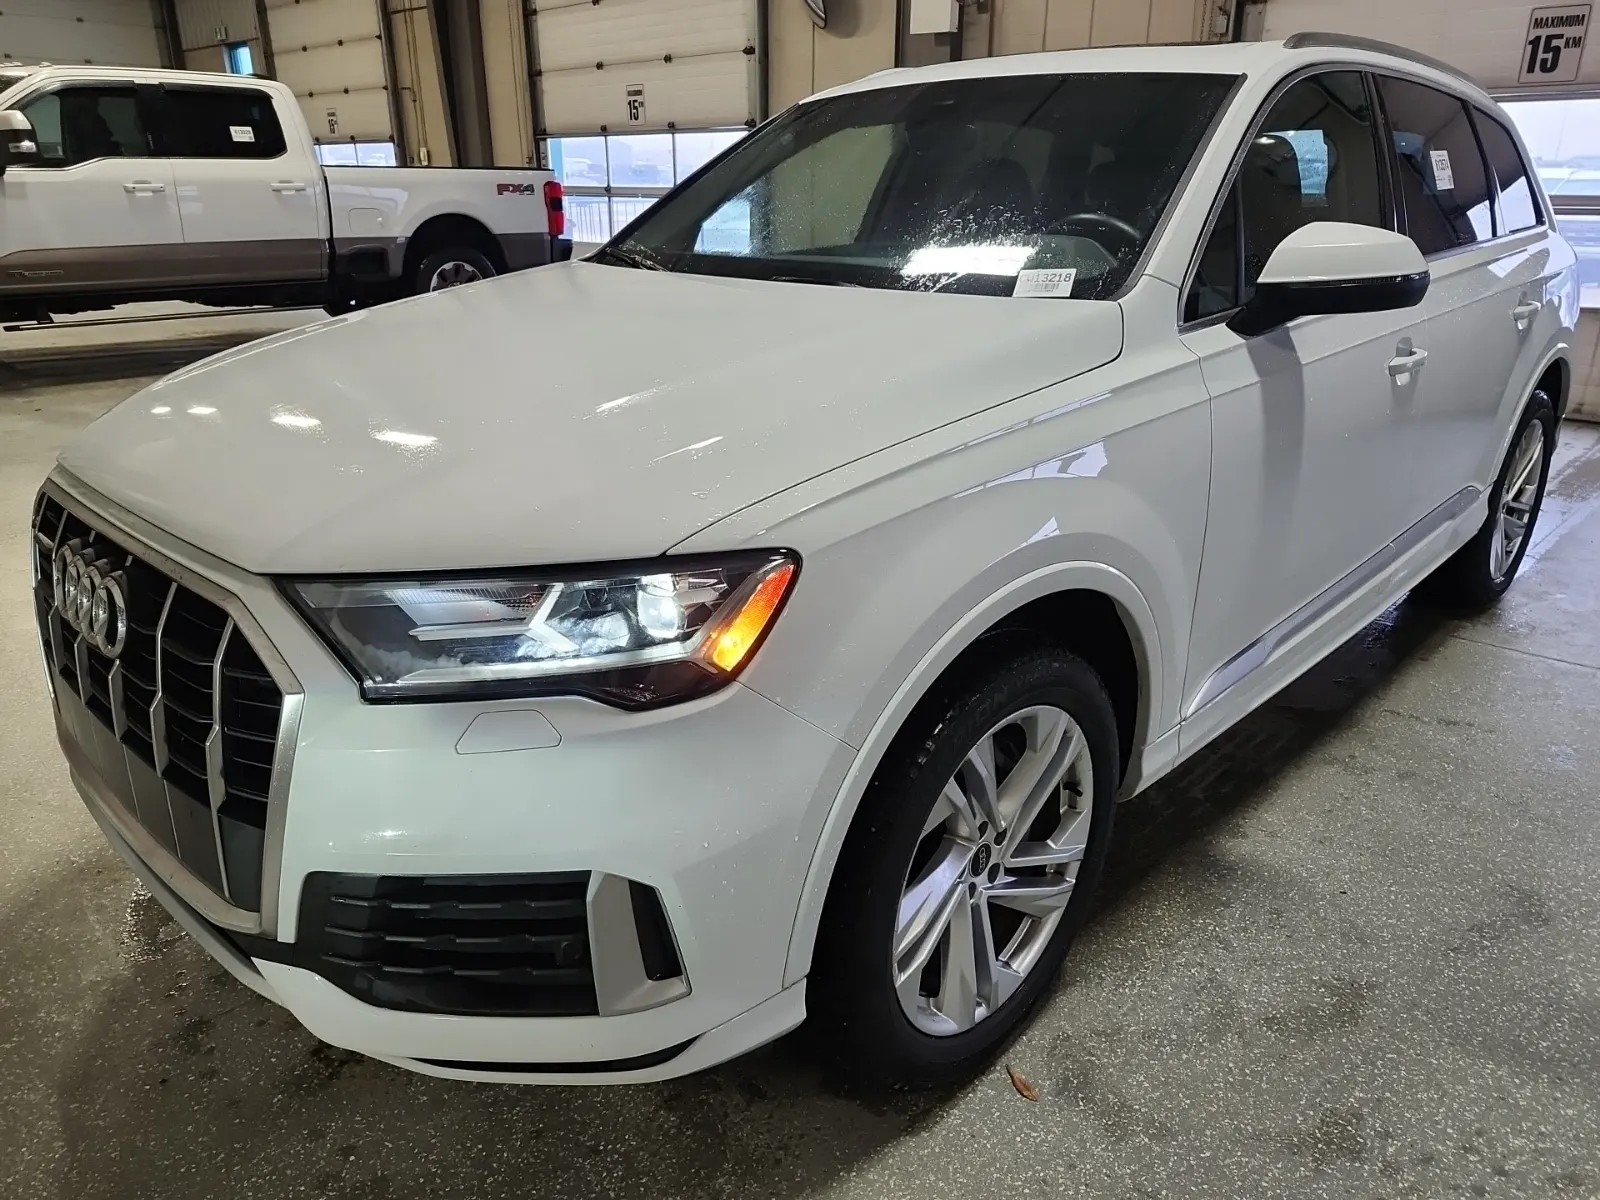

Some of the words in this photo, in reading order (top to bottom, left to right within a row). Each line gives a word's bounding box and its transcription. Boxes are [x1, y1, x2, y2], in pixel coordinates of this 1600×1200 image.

[1533, 14, 1586, 29] MAXIMUM
[1526, 34, 1564, 74] 15
[1564, 36, 1582, 49] KM
[627, 99, 639, 121] 15
[497, 183, 535, 195] FX4
